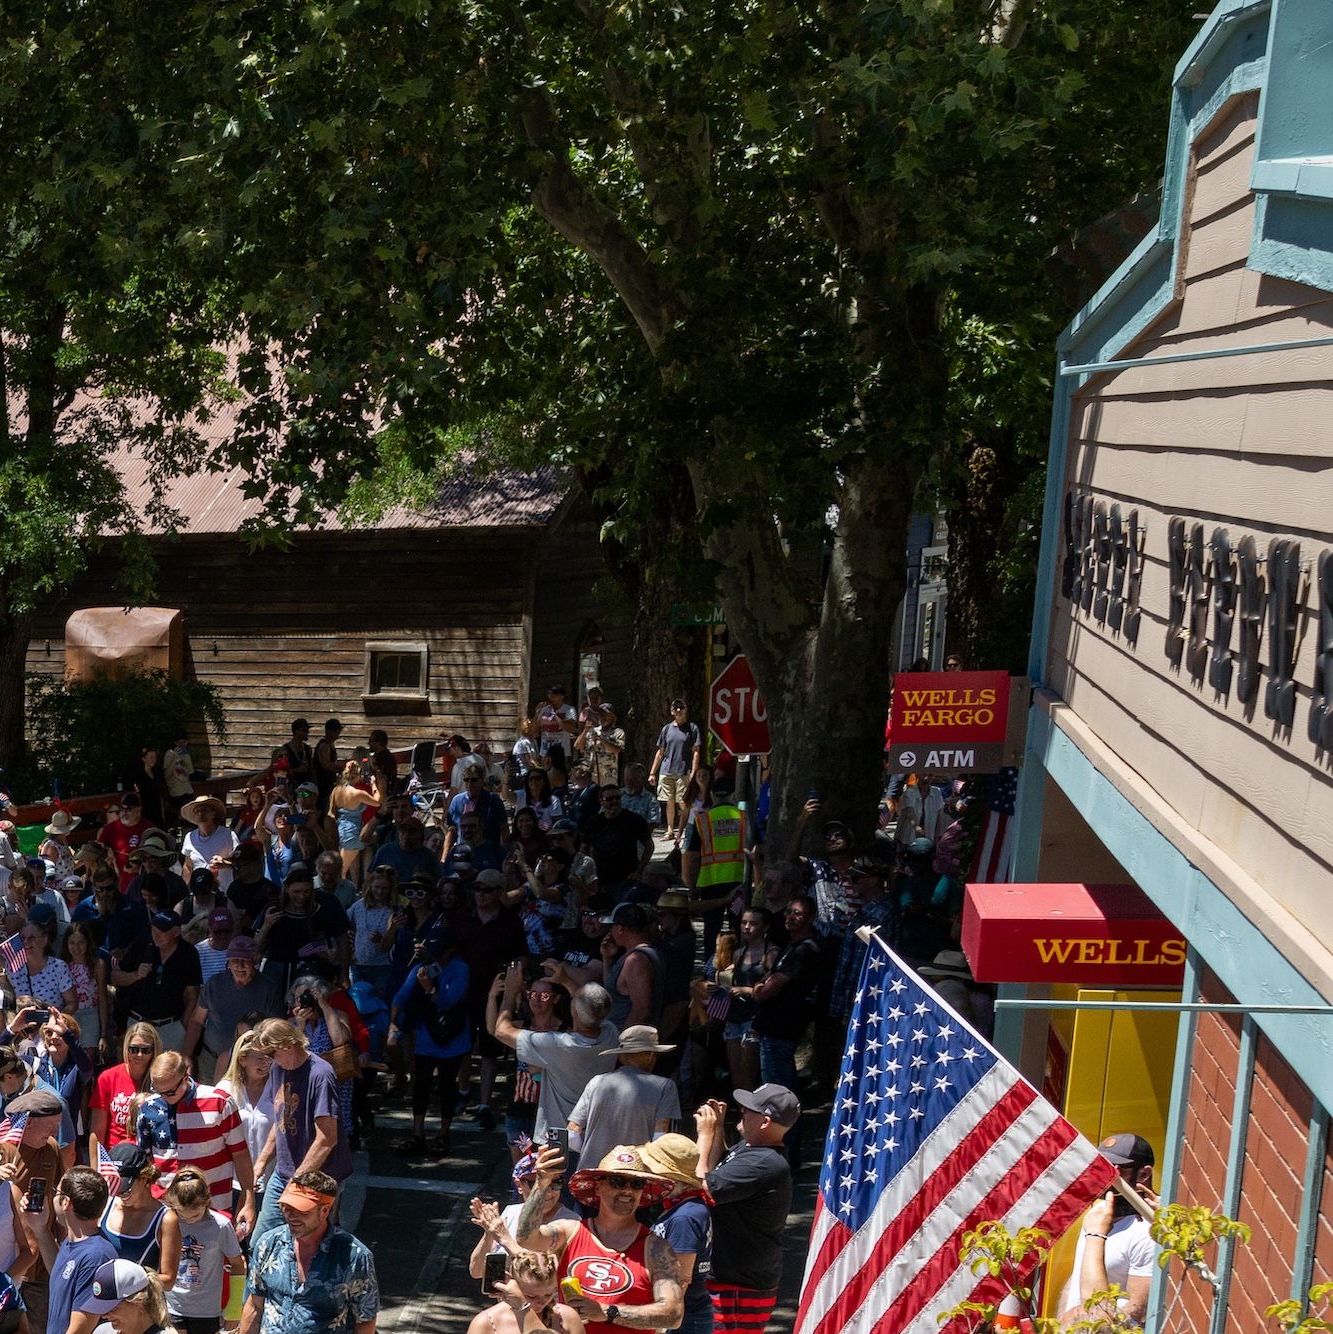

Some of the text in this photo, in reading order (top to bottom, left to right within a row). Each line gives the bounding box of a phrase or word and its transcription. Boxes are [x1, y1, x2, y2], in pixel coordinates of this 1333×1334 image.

[901, 688, 996, 707] WELLS
[901, 709, 995, 727] FARGO
[924, 749, 975, 768] ATM
[1033, 939, 1186, 965] WELLS
